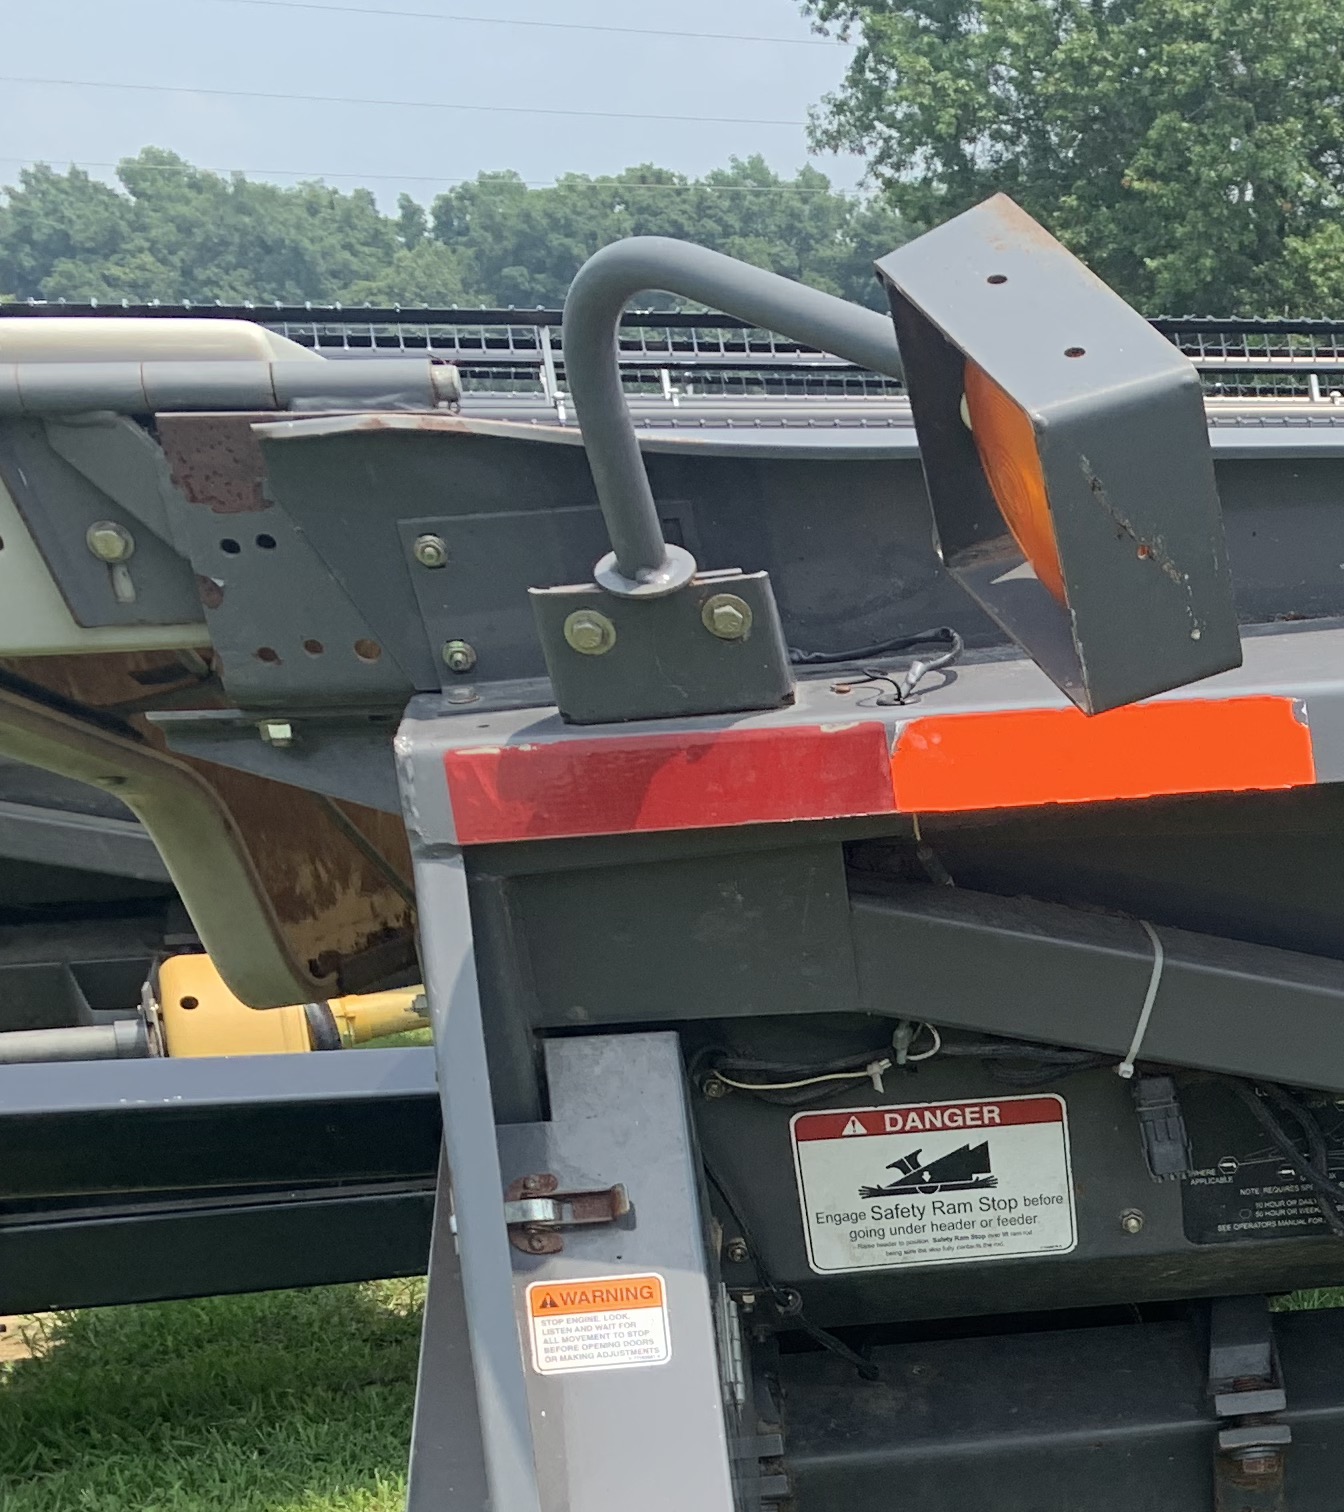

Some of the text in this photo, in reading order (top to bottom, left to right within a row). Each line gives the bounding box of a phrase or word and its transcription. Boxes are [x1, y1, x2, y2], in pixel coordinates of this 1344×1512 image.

[884, 1105, 1001, 1132] DANGER
[816, 1194, 1063, 1227] Engage Safety Ram Stop before
[849, 1213, 1038, 1242] going under header or feeder
[1217, 1223, 1232, 1232] SEE
[1233, 1220, 1277, 1231] OPERATORS
[1277, 1218, 1307, 1227] MANUAL
[932, 1236, 953, 1244] Safety
[971, 1233, 986, 1241] Stop
[560, 1285, 654, 1306] WARNING
[541, 1319, 564, 1327] STOP
[542, 1327, 572, 1336] LISTEN
[574, 1325, 593, 1333] AND
[595, 1323, 616, 1331] WAIT
[543, 1337, 561, 1345] ALL
[561, 1333, 610, 1343] MOVEMENT
[627, 1329, 650, 1338] STOP
[544, 1338, 654, 1354] BEFORE OPENING DOORS
[544, 1355, 558, 1363] OR
[560, 1352, 595, 1361] MAKING
[597, 1347, 660, 1358] ADJUSTMENTS
